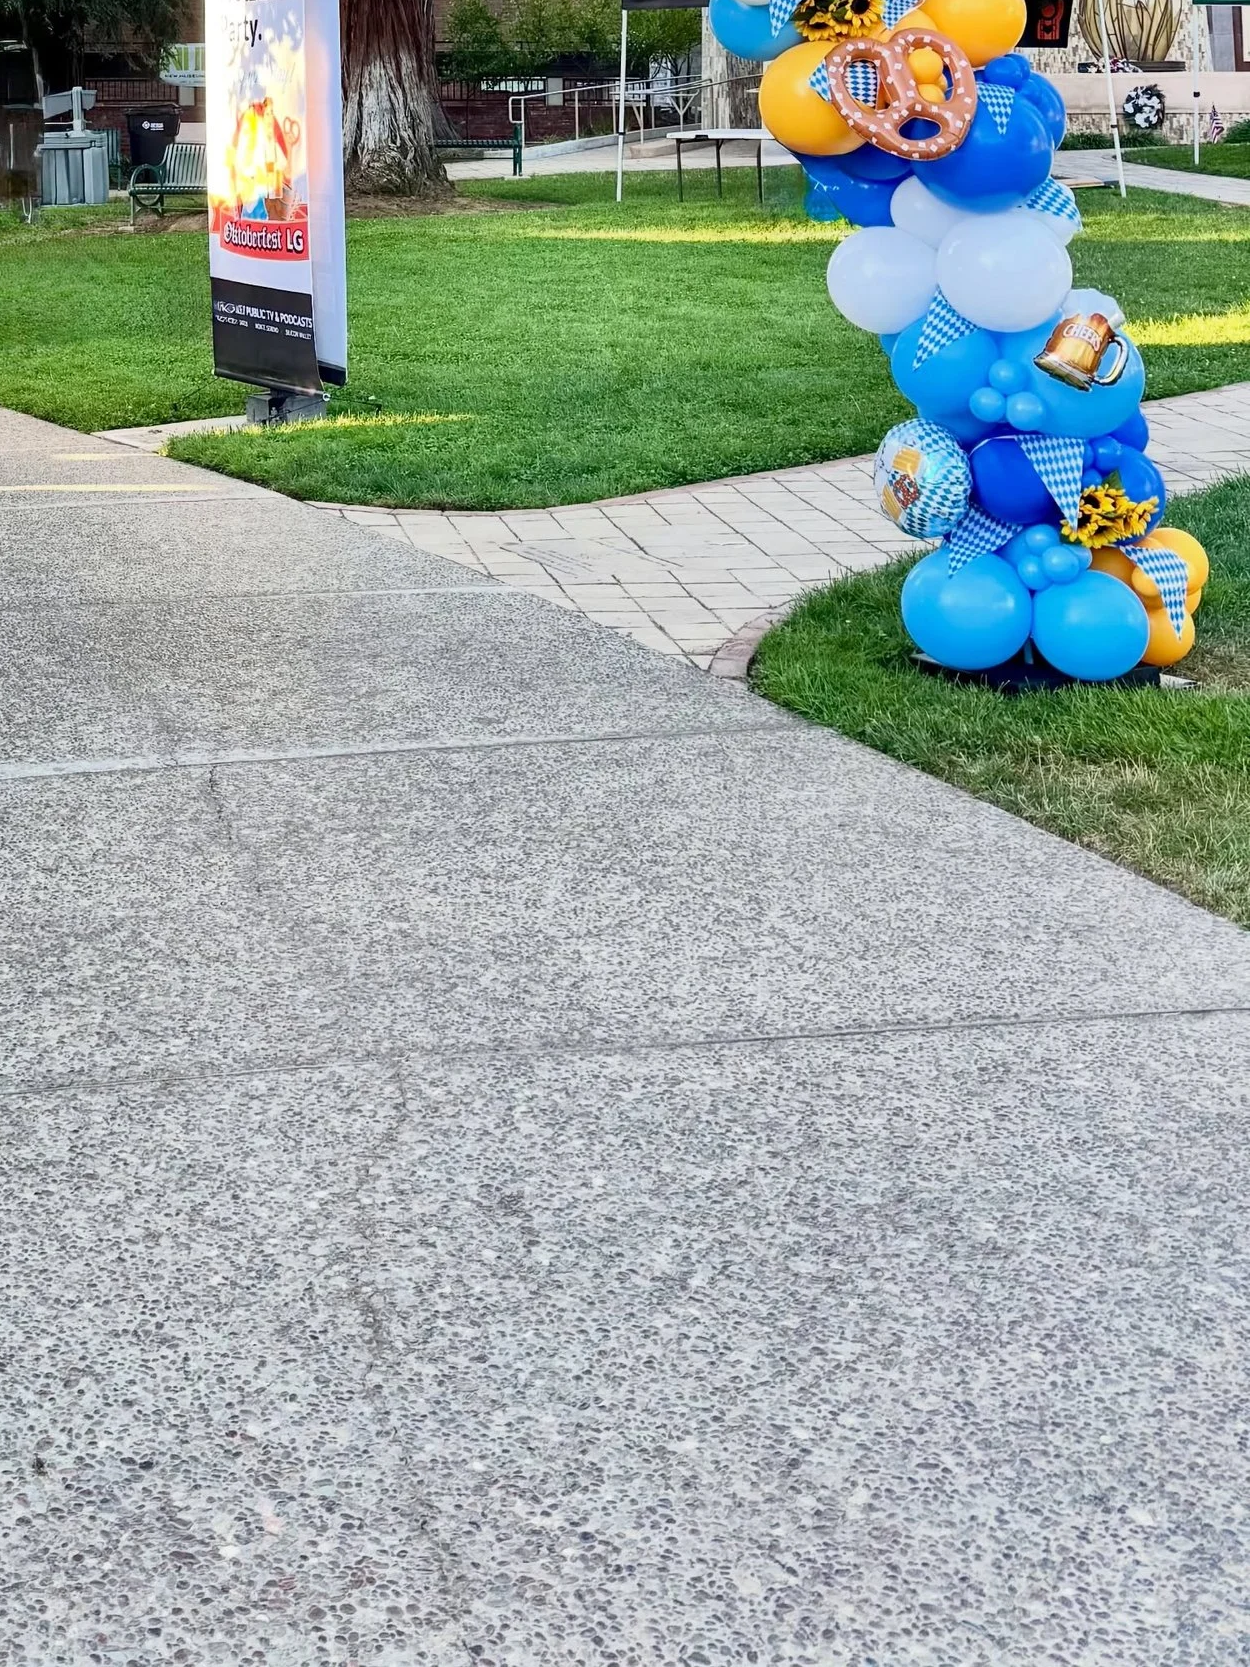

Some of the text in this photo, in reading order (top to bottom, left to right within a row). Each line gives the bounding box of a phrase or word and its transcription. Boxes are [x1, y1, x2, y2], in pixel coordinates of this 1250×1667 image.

[224, 221, 304, 251] Oktoberfest LG
[280, 312, 313, 329] PODCASTS
[1063, 323, 1103, 352] CHEERS
